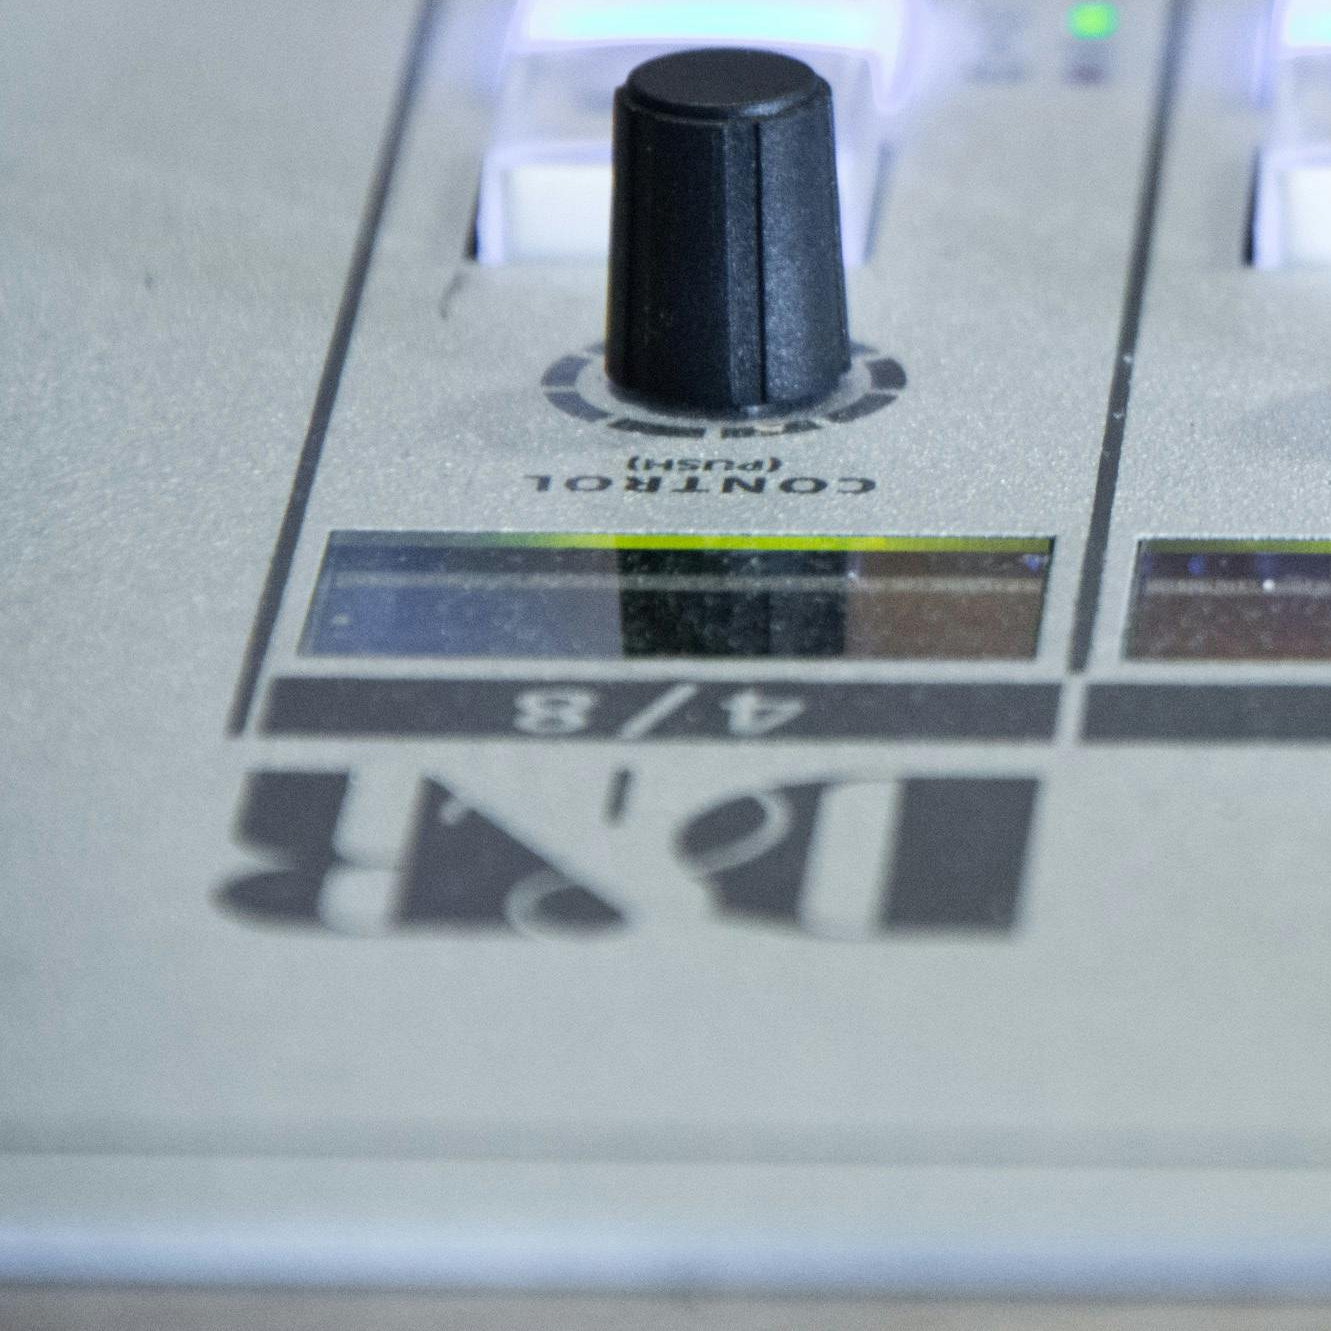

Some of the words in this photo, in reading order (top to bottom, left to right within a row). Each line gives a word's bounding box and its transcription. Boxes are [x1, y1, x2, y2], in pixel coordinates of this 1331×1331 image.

[624, 455, 783, 473] (PUSH)
[522, 474, 877, 497] CONTROL
[511, 680, 806, 740] 4/8
